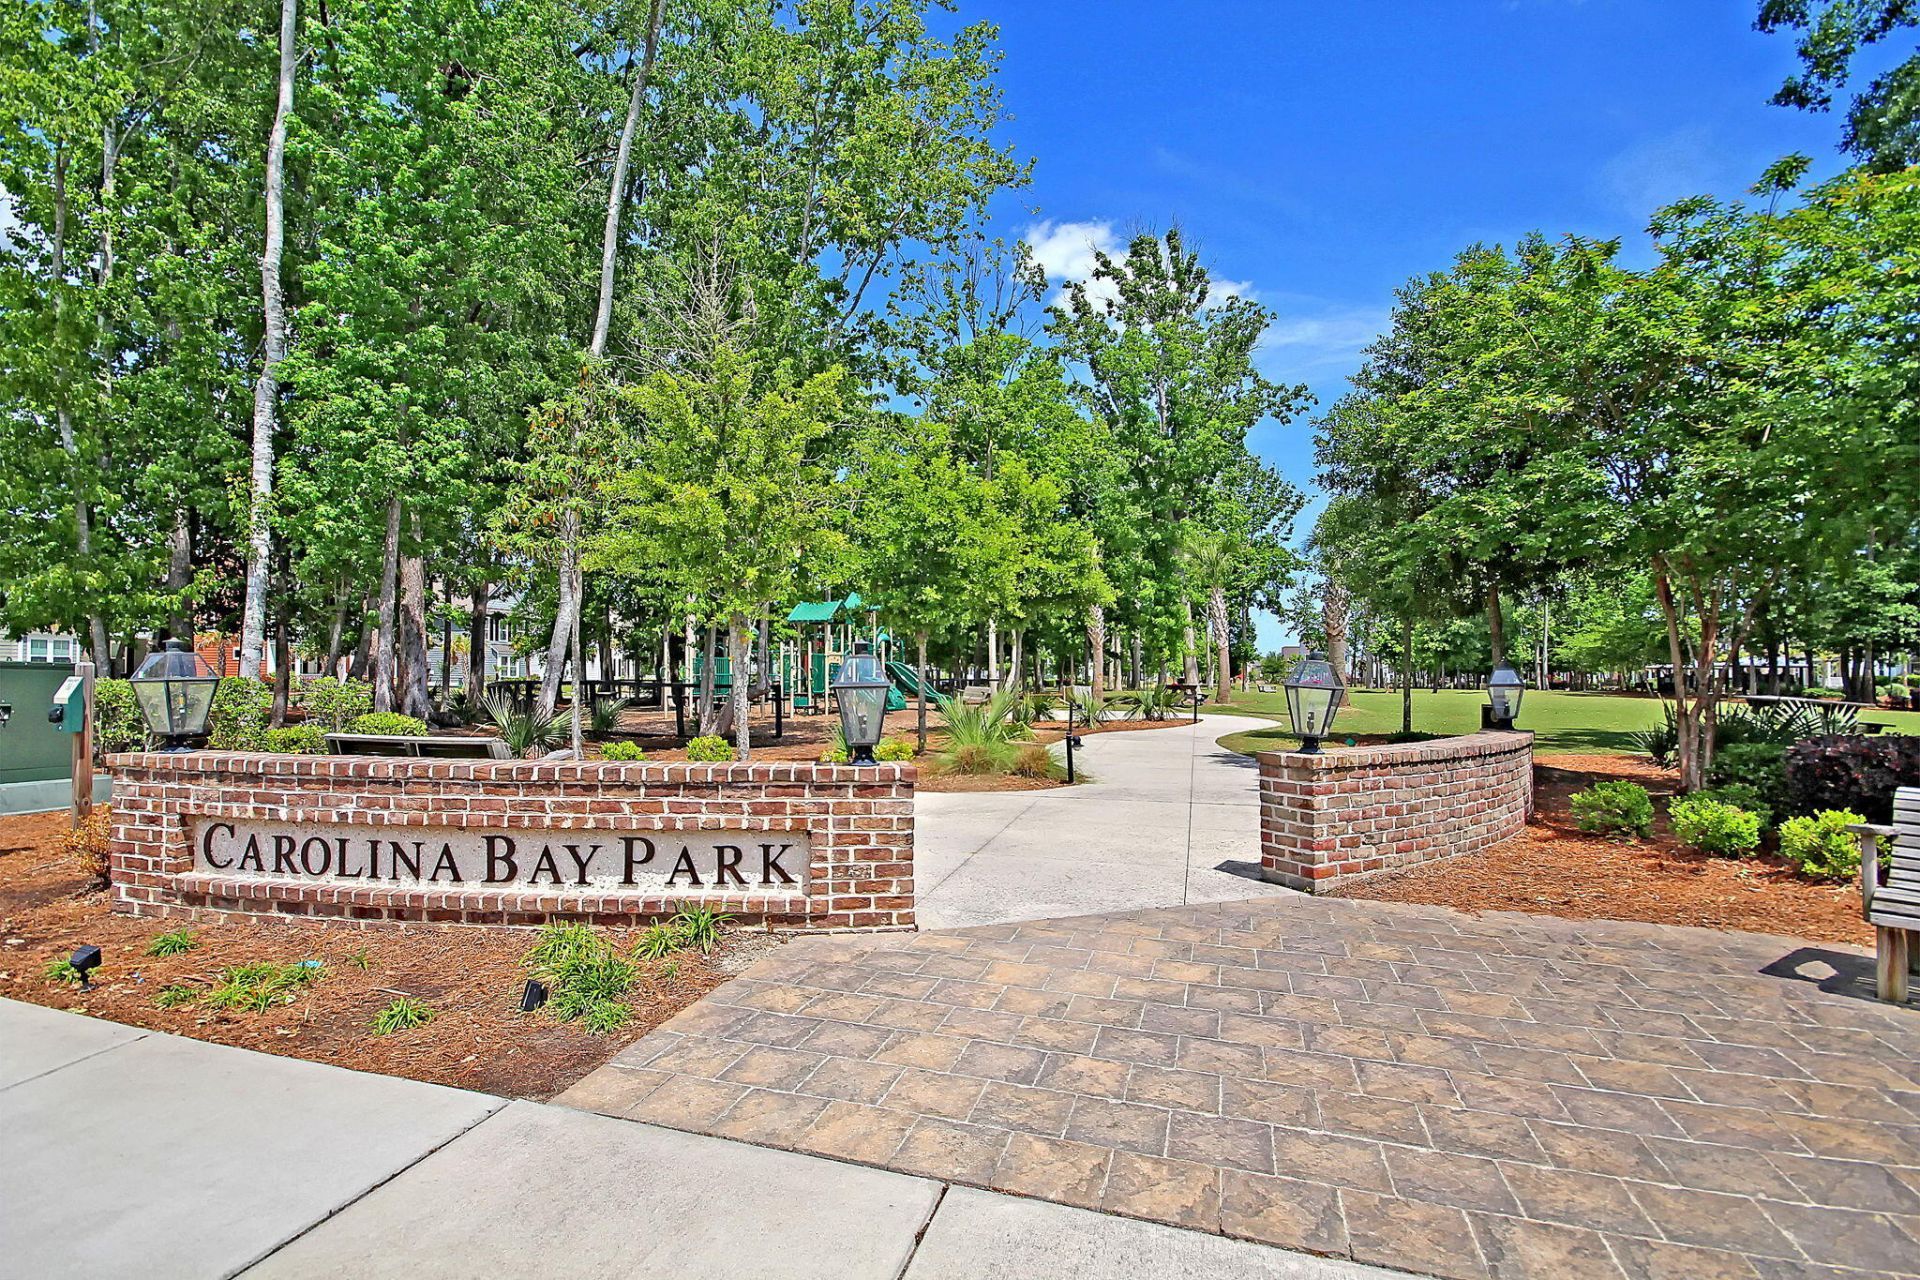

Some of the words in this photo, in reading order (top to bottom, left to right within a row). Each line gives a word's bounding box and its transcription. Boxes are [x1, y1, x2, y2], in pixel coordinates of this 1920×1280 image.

[203, 822, 464, 882] CAROLINA
[480, 835, 603, 884] BAY
[617, 836, 799, 885] PARK
